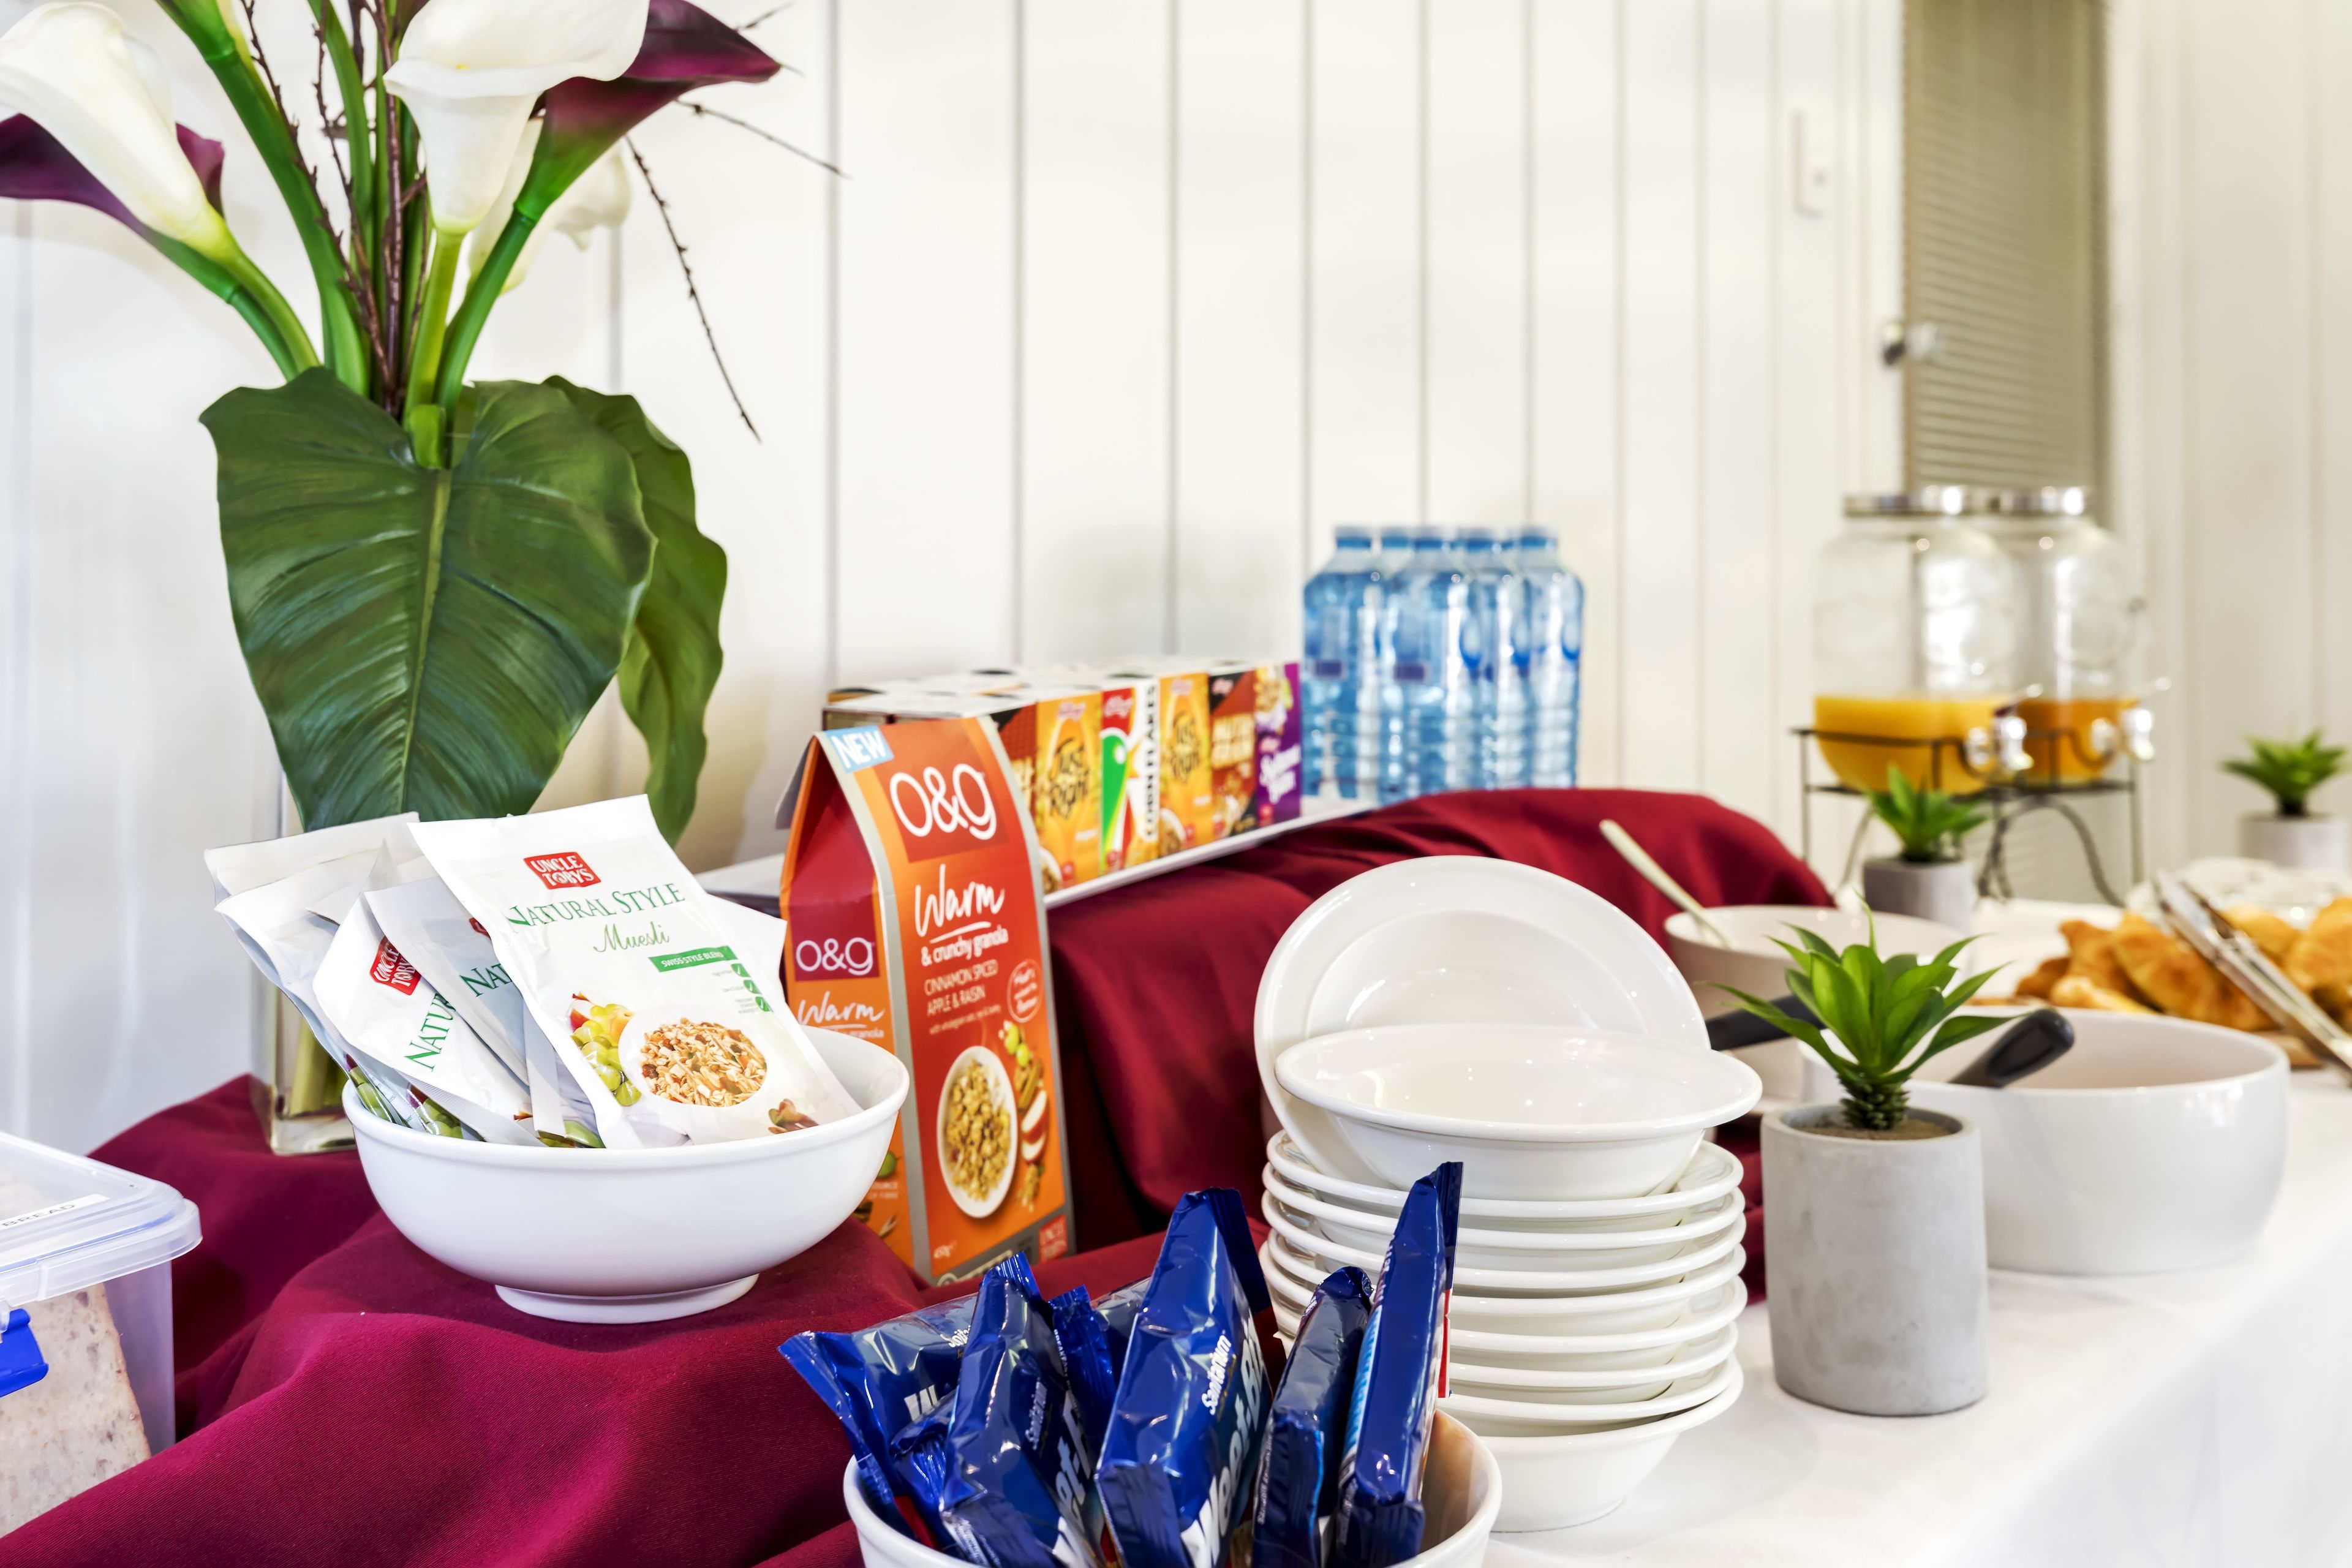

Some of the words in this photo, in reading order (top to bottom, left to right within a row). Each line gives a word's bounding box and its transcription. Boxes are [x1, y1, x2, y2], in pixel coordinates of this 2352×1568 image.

[831, 730, 887, 769] NEW
[530, 855, 583, 873] UNCLE
[542, 869, 594, 886] TOBYS
[507, 898, 617, 933] NATURAL
[612, 883, 685, 913] STYLE
[914, 864, 1006, 937] Warm
[593, 921, 669, 952] Muesli
[921, 946, 932, 967] &
[933, 935, 972, 960] crunchy
[924, 968, 972, 996] CINNAMON
[797, 990, 886, 1025] Warm
[927, 995, 951, 1017] APPLE
[2, 1204, 77, 1227] BREAD
[1201, 1335, 1232, 1415] Sanitarium
